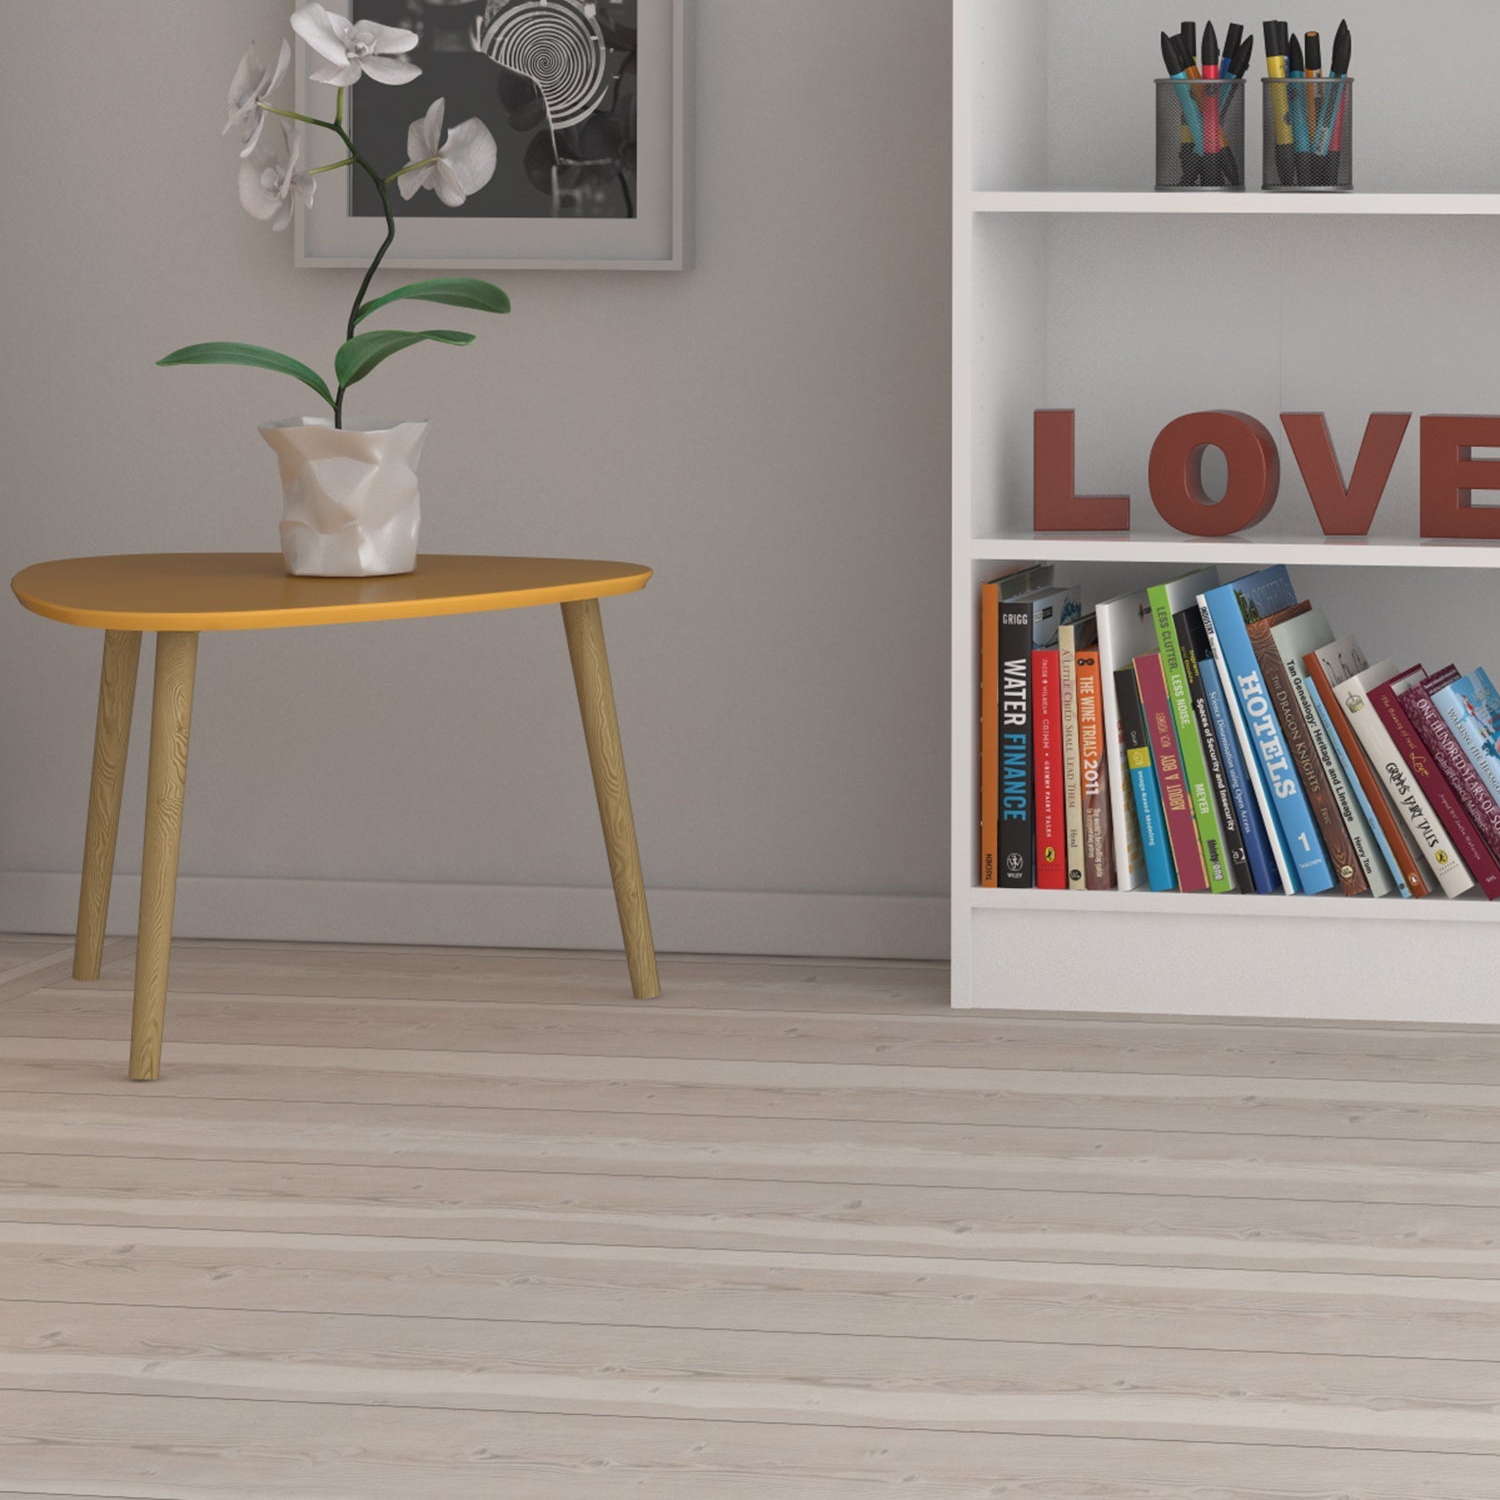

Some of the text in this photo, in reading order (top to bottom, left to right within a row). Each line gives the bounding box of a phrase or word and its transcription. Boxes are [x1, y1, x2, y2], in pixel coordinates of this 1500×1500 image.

[1002, 613, 1028, 625] GRIGG
[1156, 606, 1169, 628] LESS
[1171, 674, 1185, 698] LESS
[1003, 658, 1027, 821] WATER FINANCE
[1042, 719, 1050, 749] GRIMM
[1079, 676, 1100, 795] THE WINE TRIALS 2011
[1209, 691, 1220, 716] Science
[1233, 788, 1244, 809] Open
[1238, 670, 1311, 853] HOTELS 1
[1277, 691, 1301, 741] DRAGON
[1296, 741, 1321, 793] KNIGHTS
[1286, 658, 1298, 677] Tan
[1293, 676, 1318, 728] Genealogy:
[1313, 728, 1333, 767] Heritage
[1328, 768, 1341, 786] and
[1335, 786, 1354, 822] Lineage
[1416, 698, 1437, 723] ONE
[1430, 718, 1466, 770] HUNDRED
[1462, 771, 1488, 806] YEARS
[1481, 800, 1496, 817] OF
[1447, 707, 1473, 745] WALKING
[1160, 754, 1186, 812] ABOUT A BOY
[1195, 783, 1209, 815] MEYER
[1196, 698, 1236, 831] Spaces of Security and Insecurity
[1435, 751, 1454, 778] Gabriel
[985, 853, 993, 880] TASCHEN
[1363, 858, 1373, 875] Tom
[1416, 817, 1440, 849] TALES
